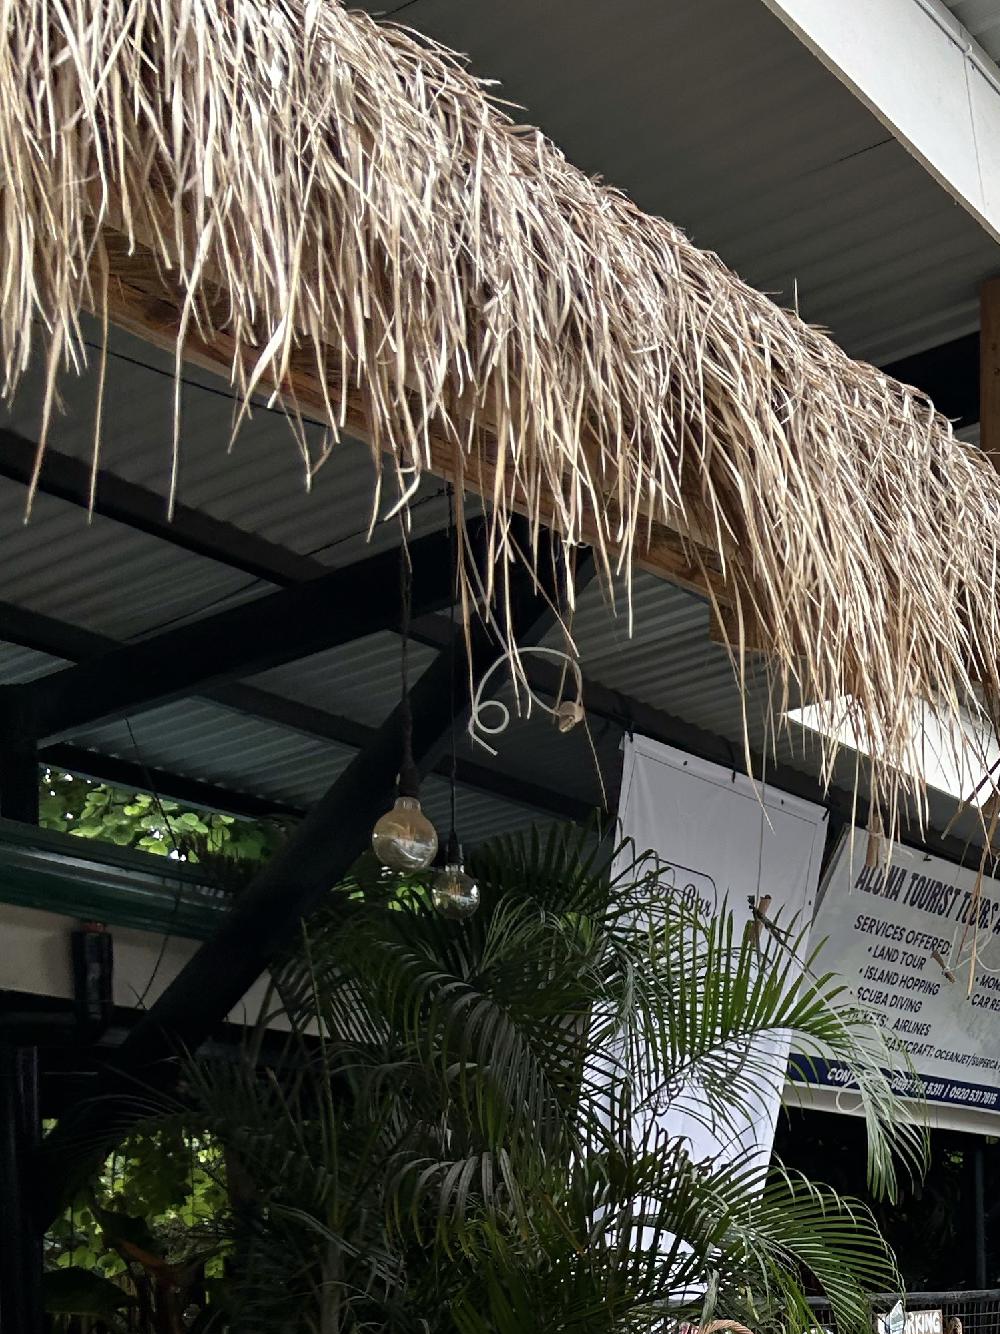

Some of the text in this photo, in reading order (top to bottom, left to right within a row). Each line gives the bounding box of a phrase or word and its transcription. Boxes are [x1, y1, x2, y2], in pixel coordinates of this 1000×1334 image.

[854, 864, 908, 902] ALONA
[902, 872, 962, 919] TOURIST
[854, 914, 953, 956] SERVICES OFFERED:
[872, 944, 927, 971] LAND TOUR
[863, 965, 941, 996] ISLAND HOPPING
[857, 986, 923, 1013] SCUBA DIVING
[971, 993, 991, 1008] CAR
[892, 1017, 932, 1037] AIRLINES
[949, 1086, 970, 1099] 0920
